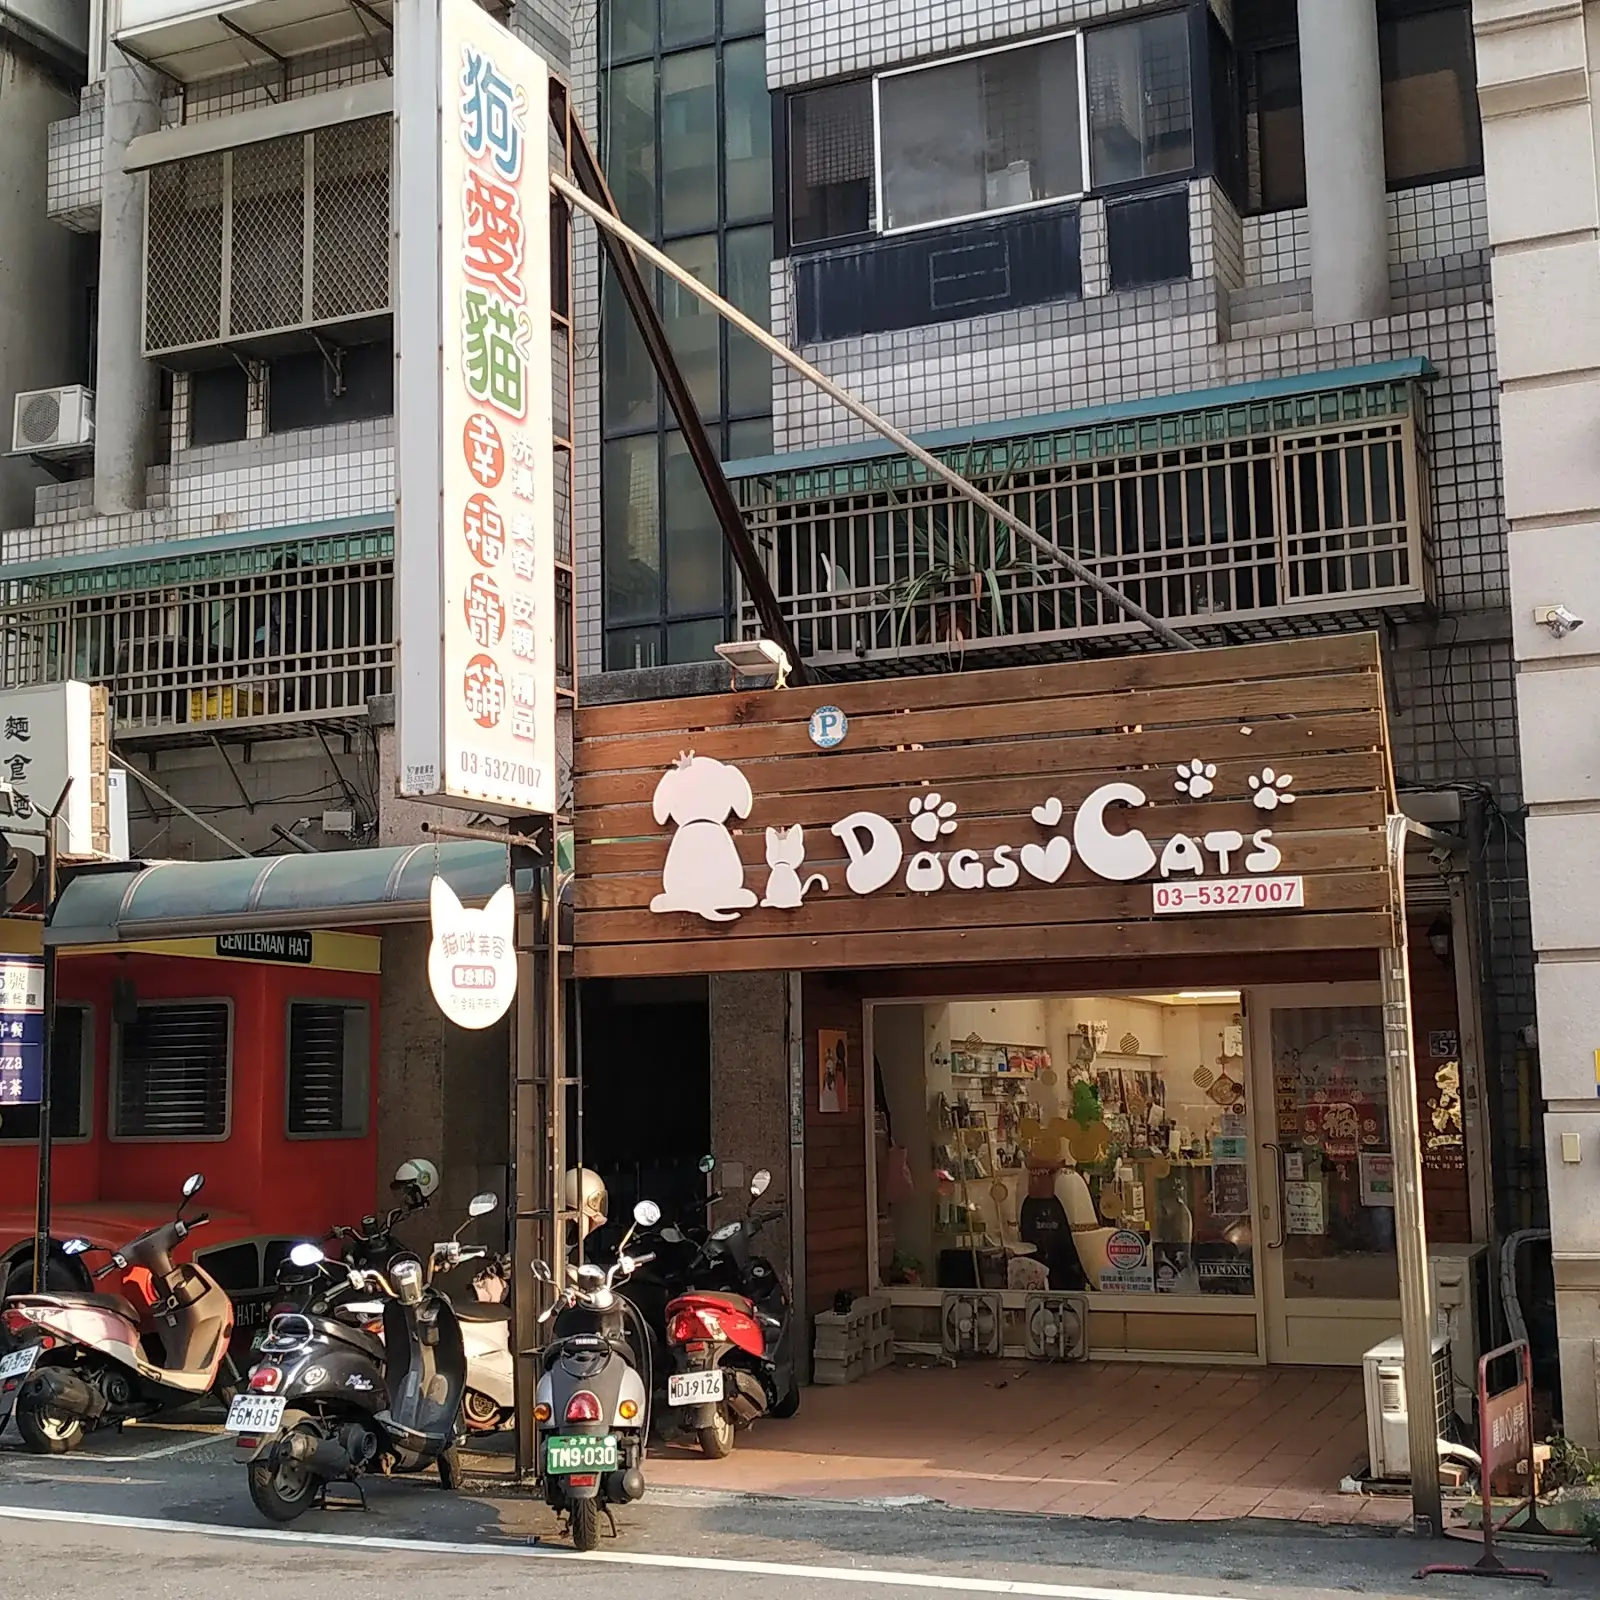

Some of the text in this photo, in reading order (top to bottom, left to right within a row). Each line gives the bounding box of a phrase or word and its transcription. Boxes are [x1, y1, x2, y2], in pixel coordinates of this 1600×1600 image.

[819, 714, 838, 737] P
[461, 751, 542, 789] 03-5327007
[1157, 882, 1296, 908] 03-5327007
[220, 933, 310, 957] GENTLEMAN HAT
[1440, 1041, 1458, 1056] 57
[1200, 1263, 1250, 1275] HYPONIC
